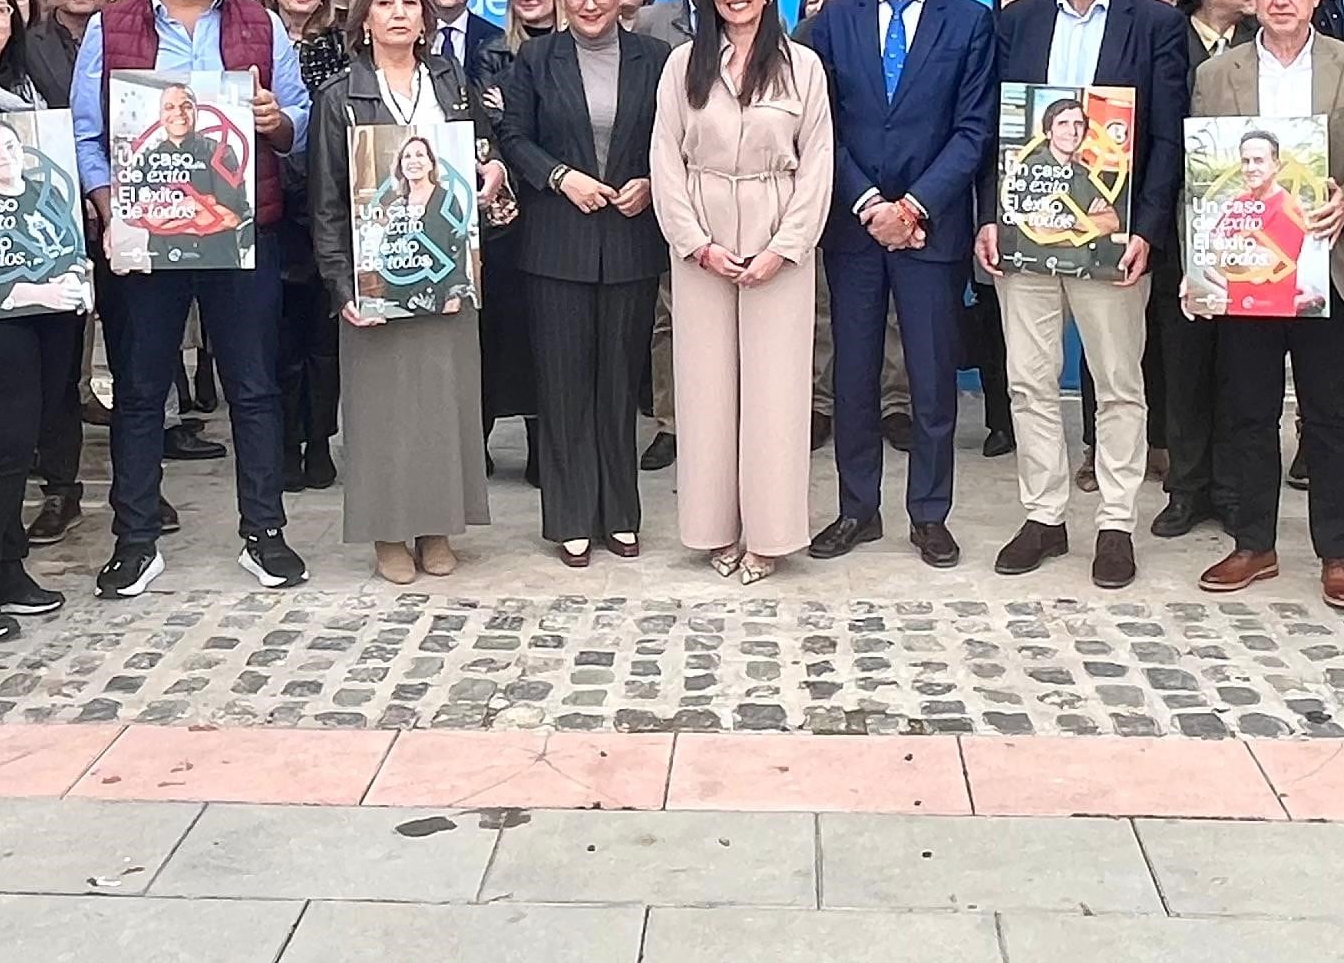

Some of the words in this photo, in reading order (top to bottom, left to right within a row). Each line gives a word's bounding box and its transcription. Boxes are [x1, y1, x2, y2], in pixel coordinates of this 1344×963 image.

[118, 149, 144, 167] Un
[148, 152, 194, 167] caso
[118, 168, 144, 183] de
[146, 166, 191, 183] éxito
[1005, 159, 1028, 176] Un
[1032, 164, 1073, 179] caso
[1006, 177, 1027, 192] de
[119, 187, 135, 203] El
[138, 187, 184, 203] éxito
[1004, 194, 1019, 211] El
[1022, 195, 1063, 212] éxito
[119, 203, 143, 219] de
[359, 205, 383, 220] Un
[1193, 197, 1217, 214] Un
[1221, 200, 1265, 215] caso
[360, 221, 384, 236] de
[1193, 215, 1217, 230] de
[380, 239, 419, 255] éxito
[1194, 233, 1209, 250] El
[361, 255, 383, 271] de
[387, 253, 433, 270] todos
[1193, 250, 1217, 266] de
